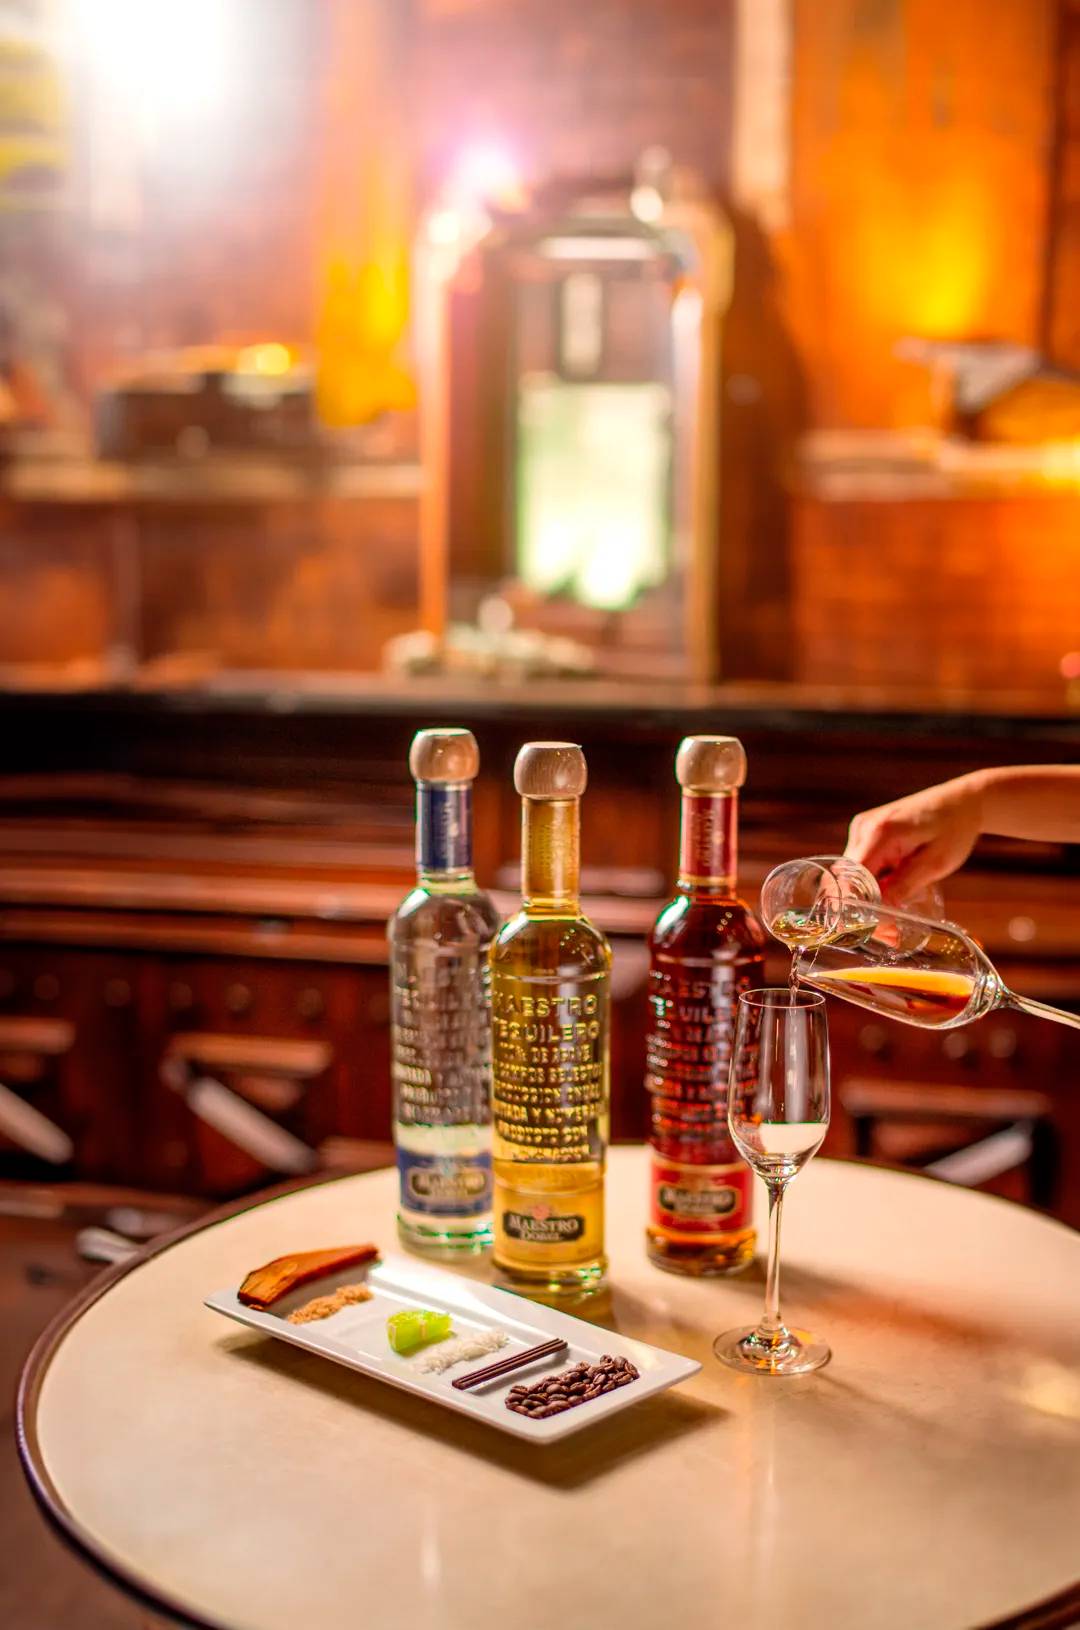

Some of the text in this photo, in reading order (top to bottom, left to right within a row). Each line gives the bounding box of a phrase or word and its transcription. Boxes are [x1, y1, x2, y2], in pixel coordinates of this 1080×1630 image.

[493, 990, 598, 1018] MAESTRO
[493, 1017, 600, 1043] TEQUILERO
[509, 1215, 580, 1233] MAESTRO
